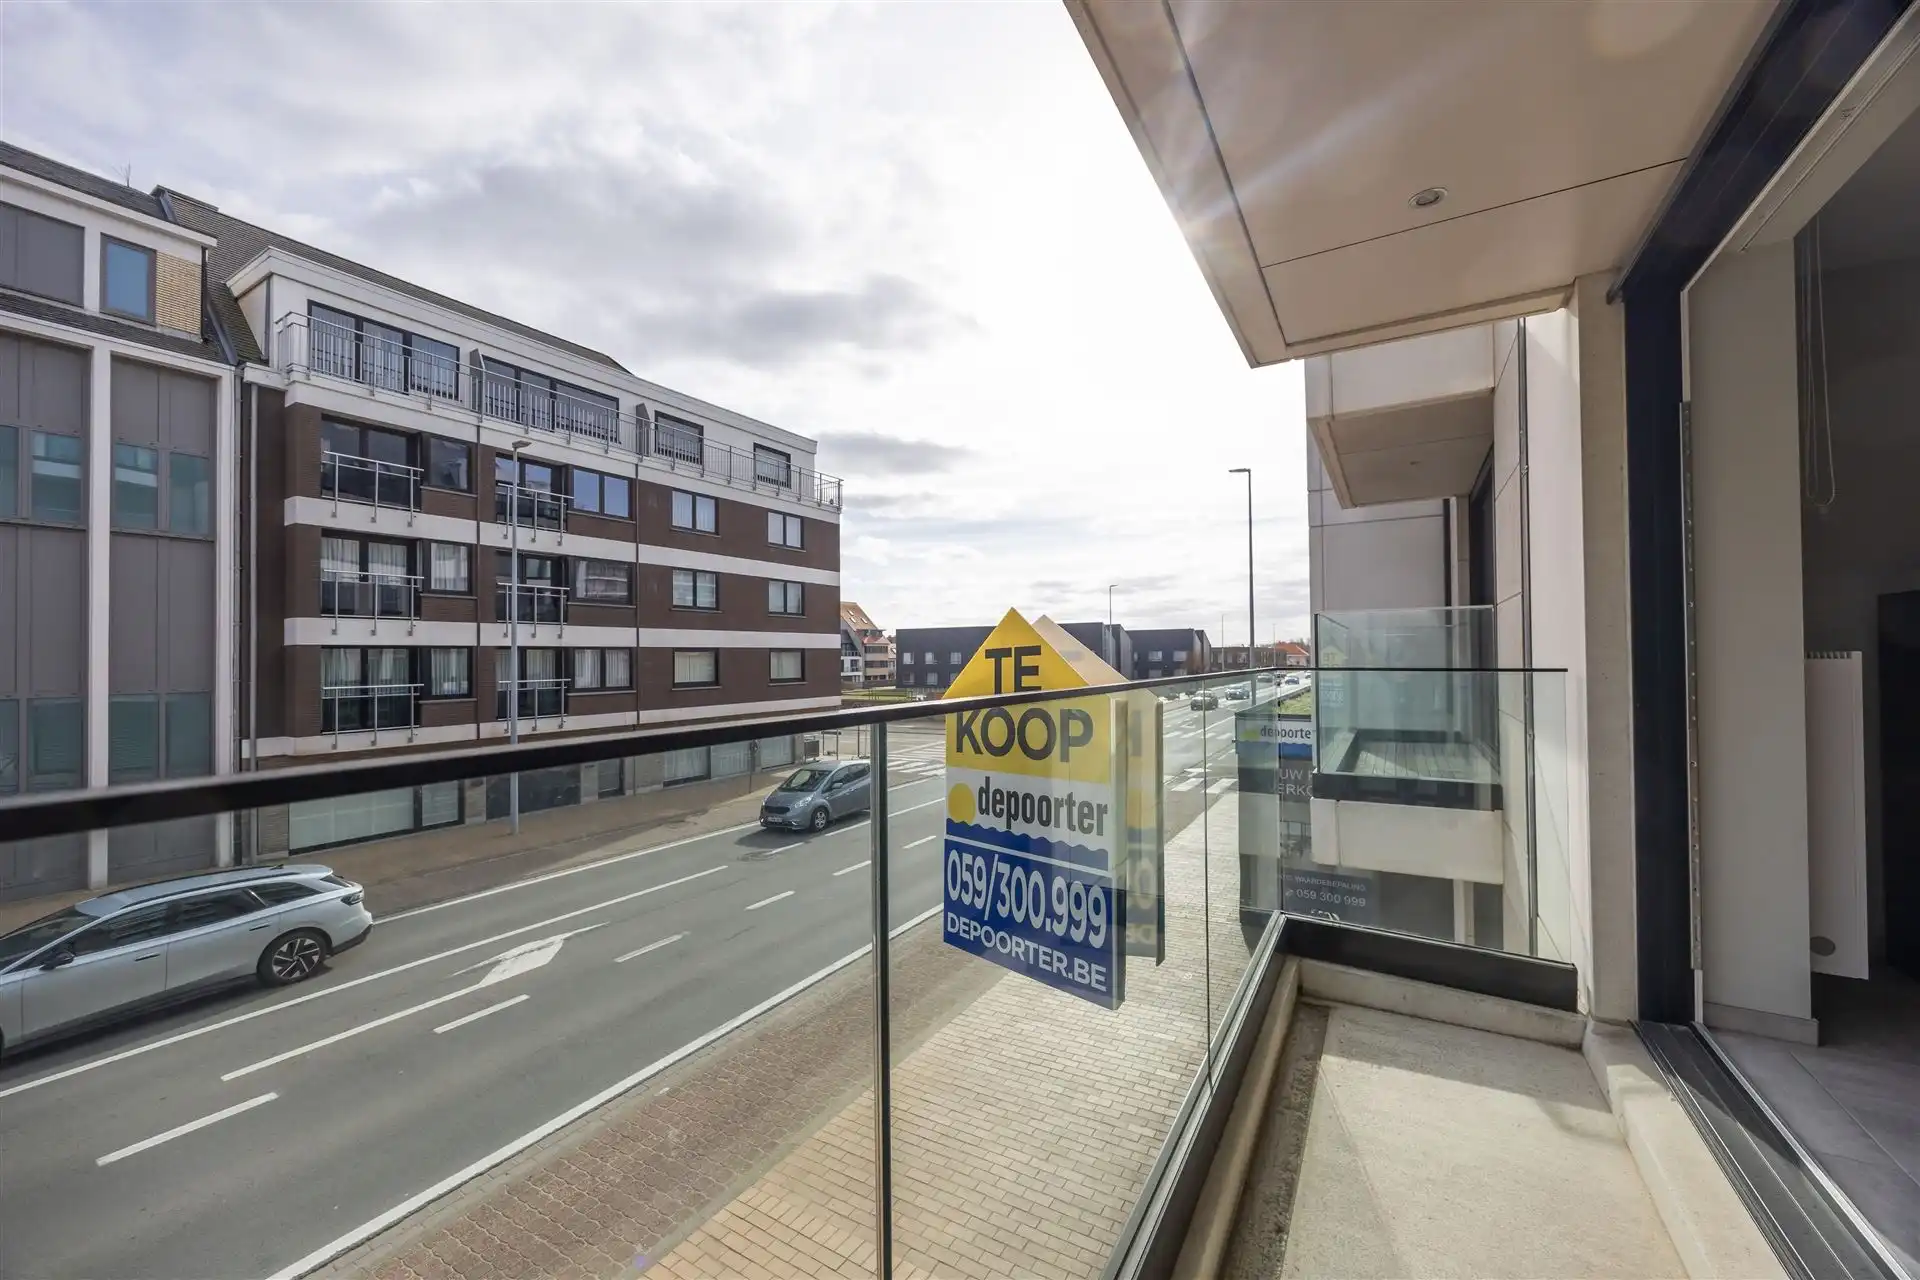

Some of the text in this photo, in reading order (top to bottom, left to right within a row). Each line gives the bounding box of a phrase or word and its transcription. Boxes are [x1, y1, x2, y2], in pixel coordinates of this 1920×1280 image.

[985, 645, 1042, 695] TE
[955, 706, 1094, 763] KOOP
[978, 776, 1108, 836] depoorter
[947, 849, 1107, 949] 059/300.999
[1296, 888, 1317, 900] 059
[1320, 891, 1341, 904] 300
[947, 912, 1107, 992] DEPOORTER.BE
